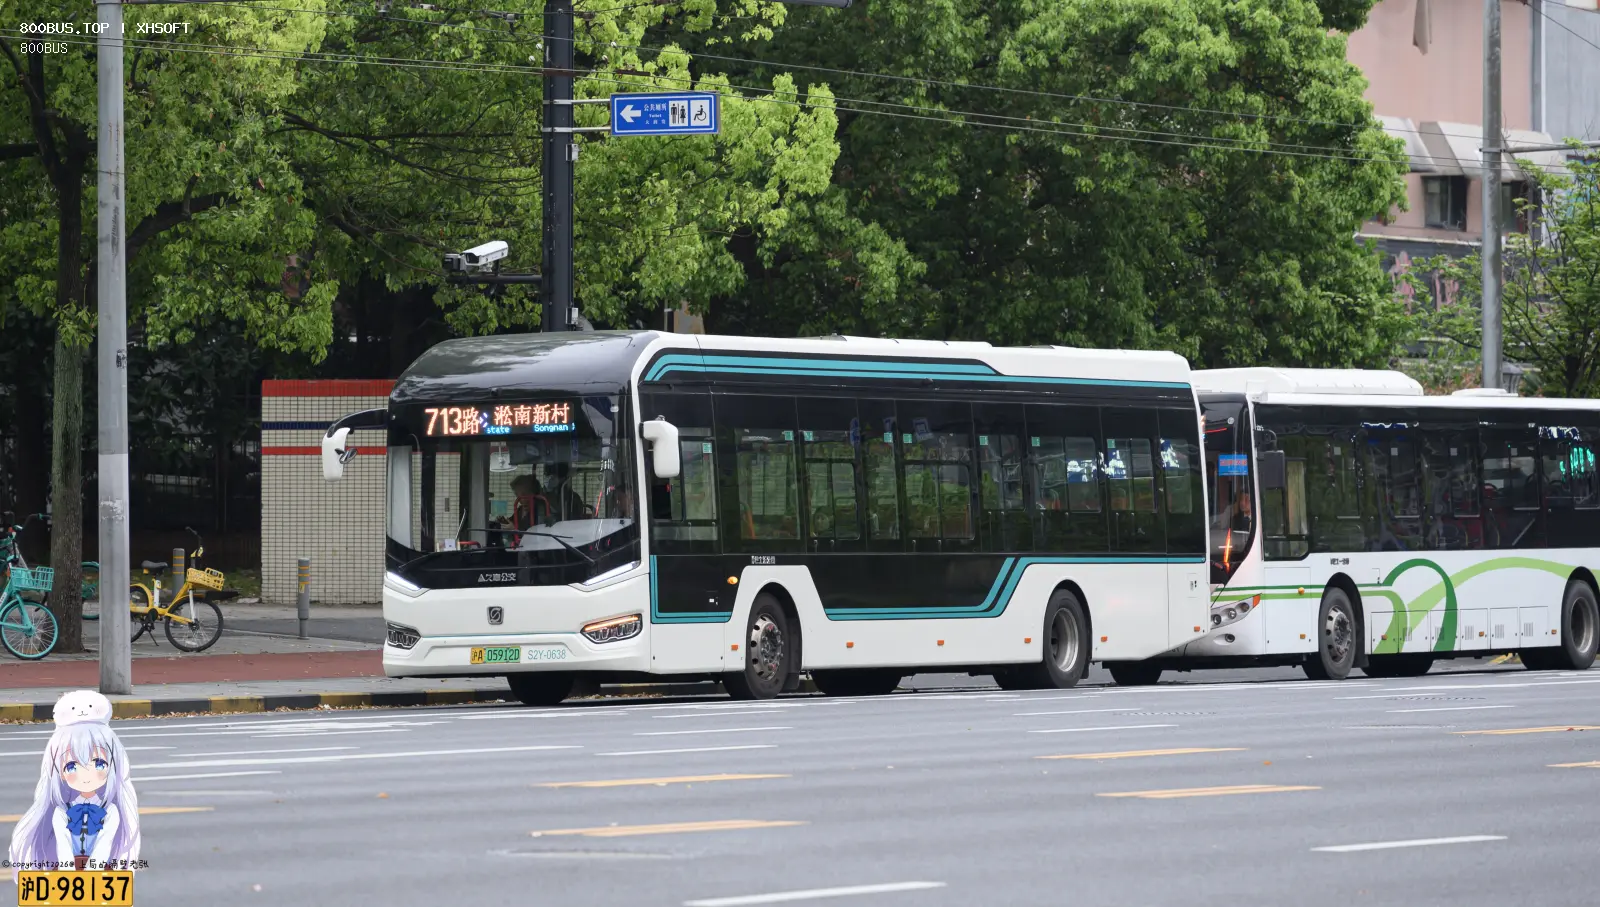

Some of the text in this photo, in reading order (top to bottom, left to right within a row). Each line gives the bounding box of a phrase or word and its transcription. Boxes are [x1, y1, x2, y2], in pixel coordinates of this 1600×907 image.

[424, 403, 570, 435] 713路 淞南新村
[534, 424, 569, 432] Songnan
[528, 649, 567, 660] S2Y-0638
